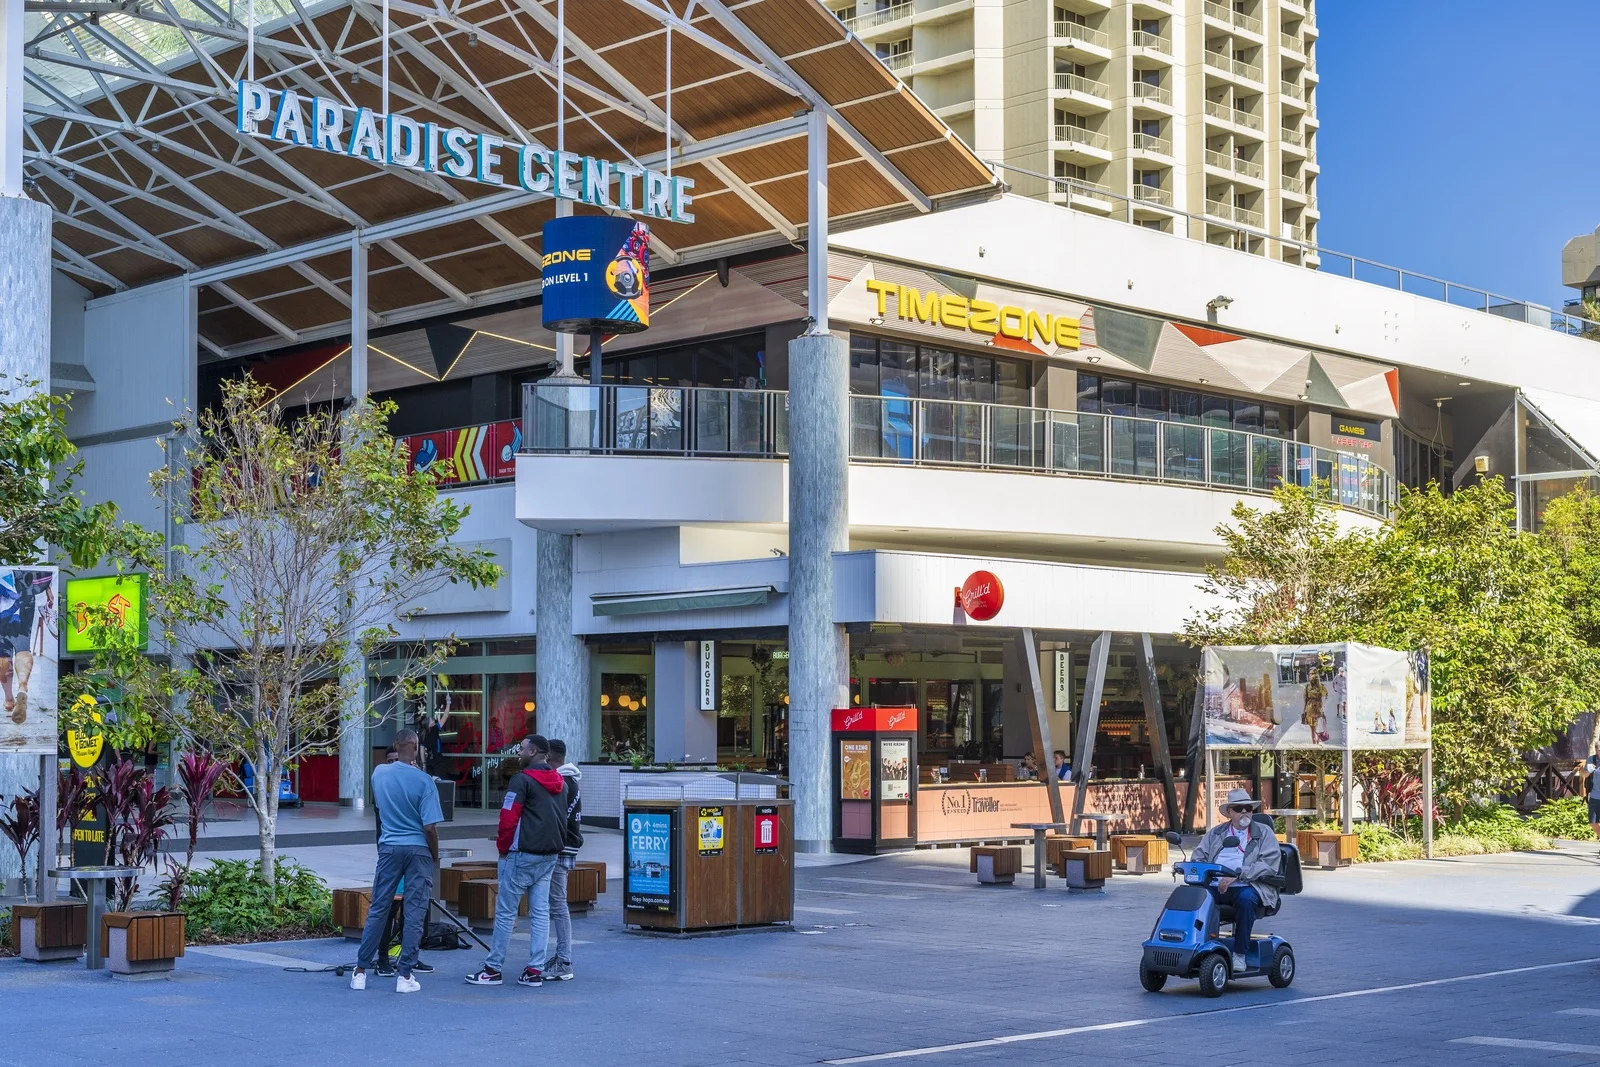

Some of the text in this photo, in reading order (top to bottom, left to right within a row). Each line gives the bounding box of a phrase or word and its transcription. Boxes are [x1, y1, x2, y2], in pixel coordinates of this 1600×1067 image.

[238, 80, 696, 224] PARADISE CENTRE
[555, 272, 580, 284] LEVEL
[584, 272, 589, 282] 1
[866, 279, 1081, 350] TIMEZONE
[1339, 424, 1365, 435] GAMES
[962, 582, 991, 609] Grill'd
[75, 594, 131, 635] BST
[844, 710, 863, 729] Grill'd
[888, 711, 906, 729] Grill'd
[971, 796, 1000, 813] Traveller
[73, 829, 85, 841] PEN
[91, 831, 105, 843] LATE
[632, 836, 668, 850] FERRY
